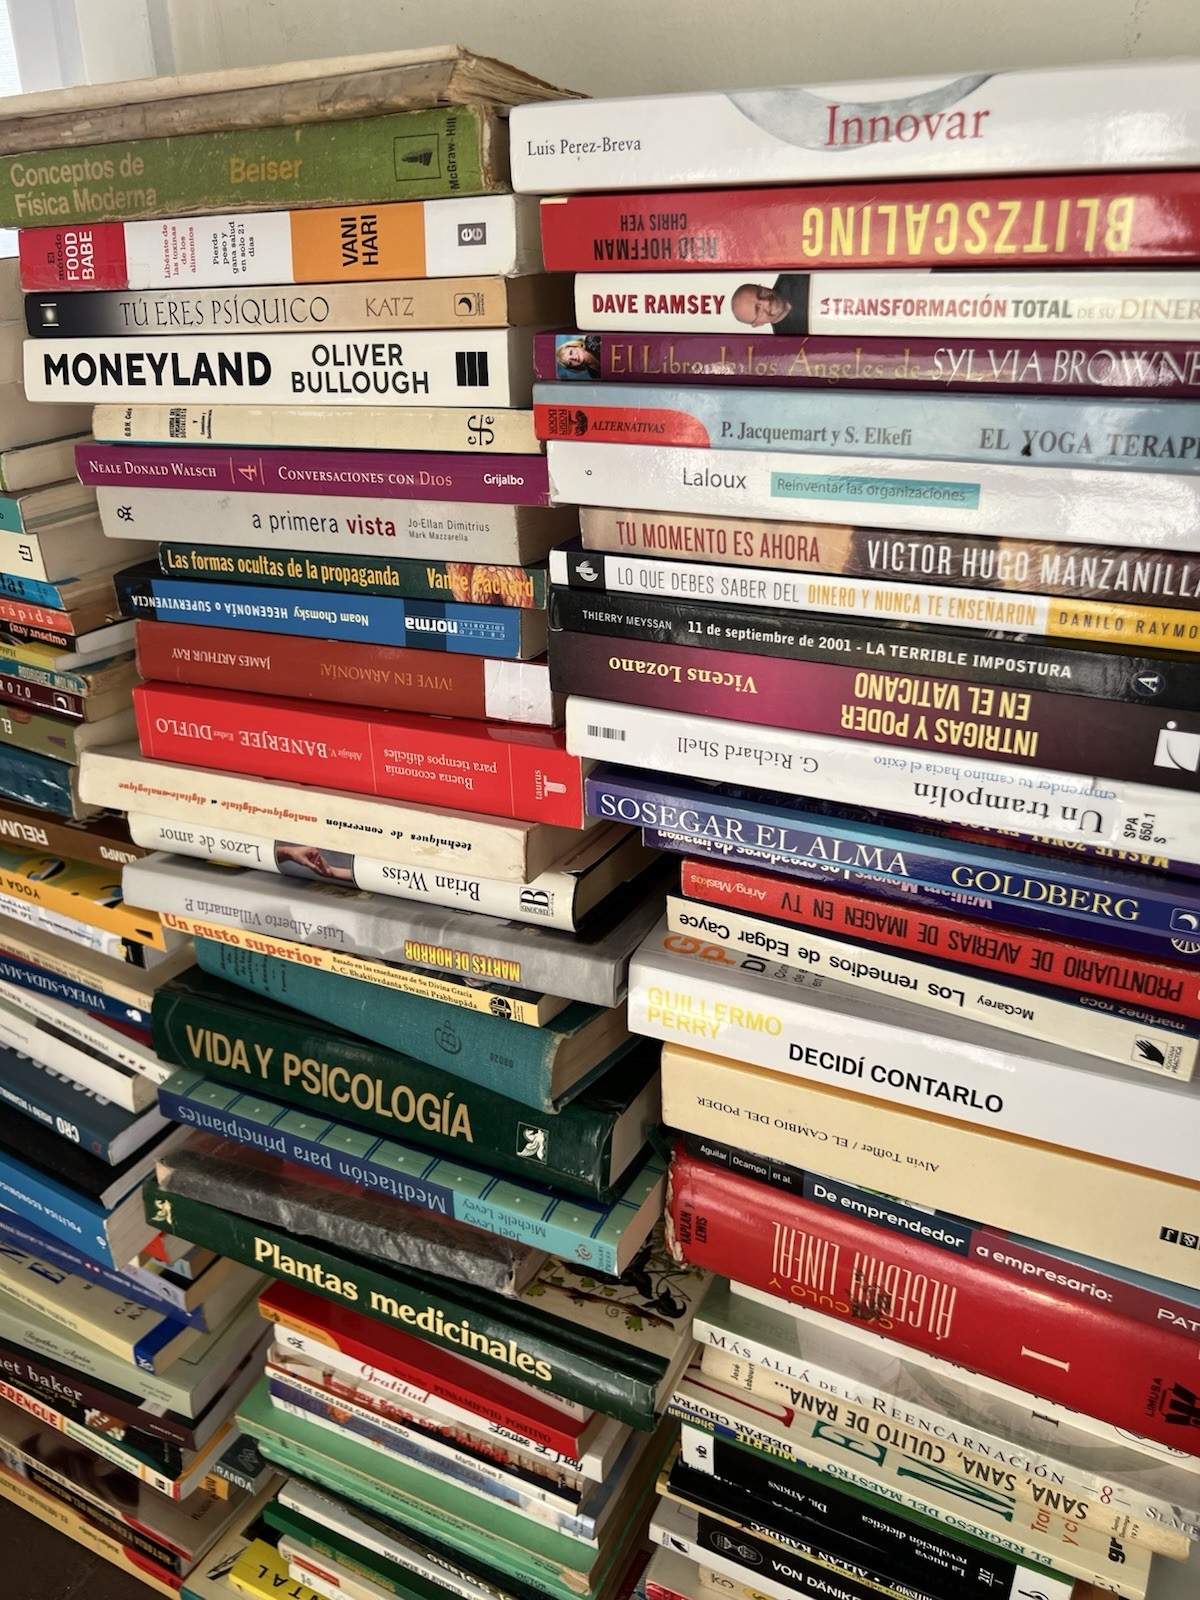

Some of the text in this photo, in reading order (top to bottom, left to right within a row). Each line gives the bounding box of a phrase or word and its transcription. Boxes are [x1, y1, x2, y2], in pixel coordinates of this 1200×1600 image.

[824, 104, 990, 146] Innovar
[528, 137, 641, 156] Luis Perez-Breva
[10, 153, 144, 188] Conceptos de
[230, 157, 302, 184] Beiser
[15, 186, 157, 218] Física Moderna
[238, 224, 244, 234] 21
[341, 217, 359, 267] VANI
[361, 214, 379, 266] HARI
[802, 196, 1135, 258] BLITZSCALING
[64, 232, 80, 281] FOOD
[80, 230, 94, 280] BABE
[181, 253, 186, 264] de
[231, 251, 239, 274] gana
[241, 260, 246, 272] en
[120, 294, 330, 328] TÚ ERES PSÍQUICO
[366, 297, 414, 317] KATZ
[593, 294, 725, 315] DAVE RAMSEY
[43, 351, 273, 388] MONEYLAND
[311, 344, 404, 366] OLIVER
[291, 371, 429, 394] BULLOUGH
[591, 420, 665, 433] ALTERNATIVAS
[683, 468, 964, 502] Laloux Reinventar las organizaciones
[253, 511, 396, 536] a primera vista
[408, 518, 490, 532] Jo-Ellan Dimitrius
[409, 531, 468, 541] Mark Mazzarella
[616, 521, 820, 563] TU MOMENTO ES AHORA
[167, 550, 535, 598] Las formas ocultas de la propaganda Vance Packard
[404, 617, 458, 634] norma
[582, 610, 1071, 679] THIERRY MEYSSAN 11 de septiembre de 2001 LA TERRIBLE IMPOSTURA
[608, 656, 758, 694] Vicens Lozano
[855, 672, 1032, 722] EN EL VATICANO
[0, 718, 13, 734] EL
[840, 704, 1039, 757] INTRIGAS Y PODER
[677, 736, 818, 772] G. Richard Shell
[385, 765, 474, 790] Buena economía
[913, 782, 1103, 833] Un trampolín
[600, 794, 910, 877] SOSEGAR EL ALMA
[7, 879, 41, 900] YOGA
[382, 866, 481, 901] Brian Weiss
[950, 866, 1139, 921] GOLDBERG
[781, 892, 1184, 1002] PRONTUARIO DE AVERIAS DE IMAGEN EN TV
[679, 914, 1034, 1020] McGarey Los remedios de Edgar Cayce
[186, 1024, 474, 1143] VIDA Y PSICOLOGÍA
[789, 1043, 1003, 1113] DECIDÍ CONTARLO
[696, 1096, 740, 1116] PODER
[744, 1110, 770, 1125] DEL
[774, 1118, 828, 1141] CAMBIO
[832, 1135, 848, 1148] EL
[178, 1105, 447, 1214] Meditación para principiantes
[699, 1144, 793, 1184] Aguilar Ocampo et al.
[906, 1157, 939, 1172] Alvin
[695, 1216, 707, 1244] LEWIS
[813, 1183, 837, 1203] De
[840, 1193, 965, 1249] emprendedor
[976, 1246, 989, 1258] a
[993, 1252, 1113, 1302] empresario:
[254, 1236, 553, 1382] Plantas medicinales
[28, 1366, 83, 1401] baker
[361, 1363, 430, 1404] Gratitud
[1145, 1377, 1163, 1417] LIMUSA
[708, 1331, 1065, 1486] MÁS ALLÁ DE LA REENCARNACIÓN
[775, 1381, 1090, 1520] SANA, SANA, CULITO DE RANA...
[910, 1536, 968, 1565] revolución
[914, 1549, 966, 1578] La nueva
